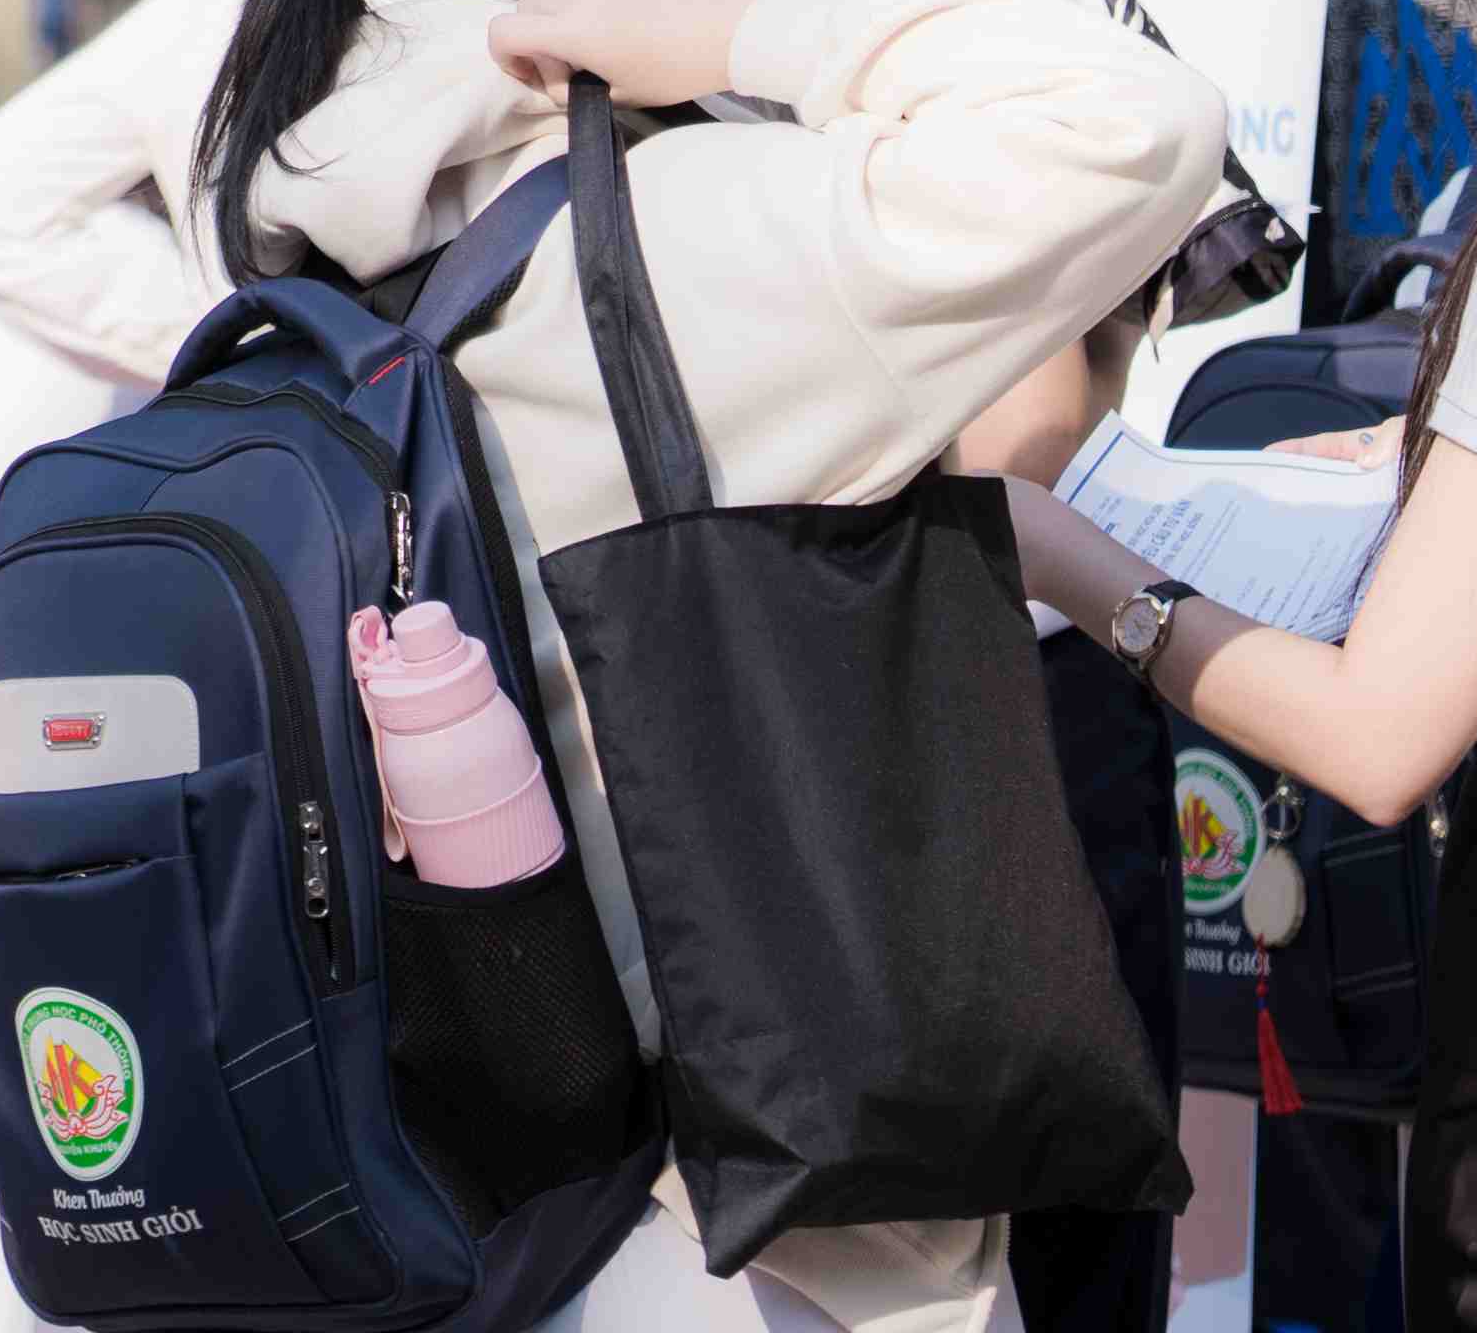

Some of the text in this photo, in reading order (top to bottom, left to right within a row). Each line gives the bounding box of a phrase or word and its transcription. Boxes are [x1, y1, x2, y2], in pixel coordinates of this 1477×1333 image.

[53, 1188, 87, 1209] Khen
[37, 1205, 204, 1245] HỌC SINH GIỎI
